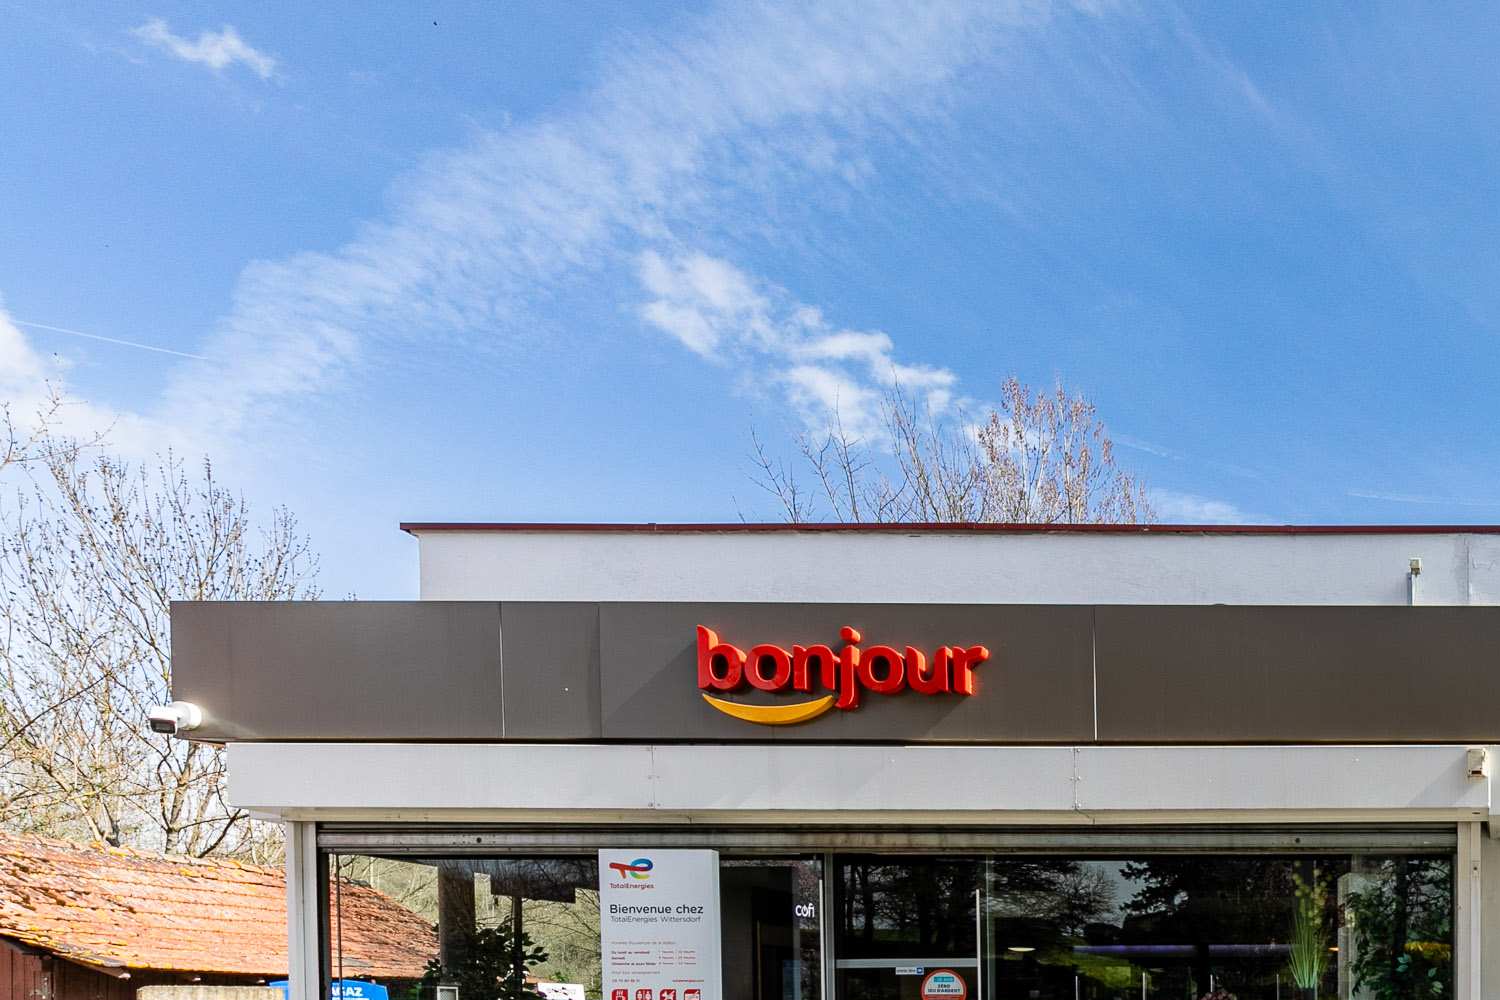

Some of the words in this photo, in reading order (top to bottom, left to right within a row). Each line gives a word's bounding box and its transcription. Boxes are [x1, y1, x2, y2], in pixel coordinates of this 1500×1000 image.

[697, 625, 989, 712] bonjour
[610, 904, 671, 913] Bienvenue
[676, 904, 704, 913] chez
